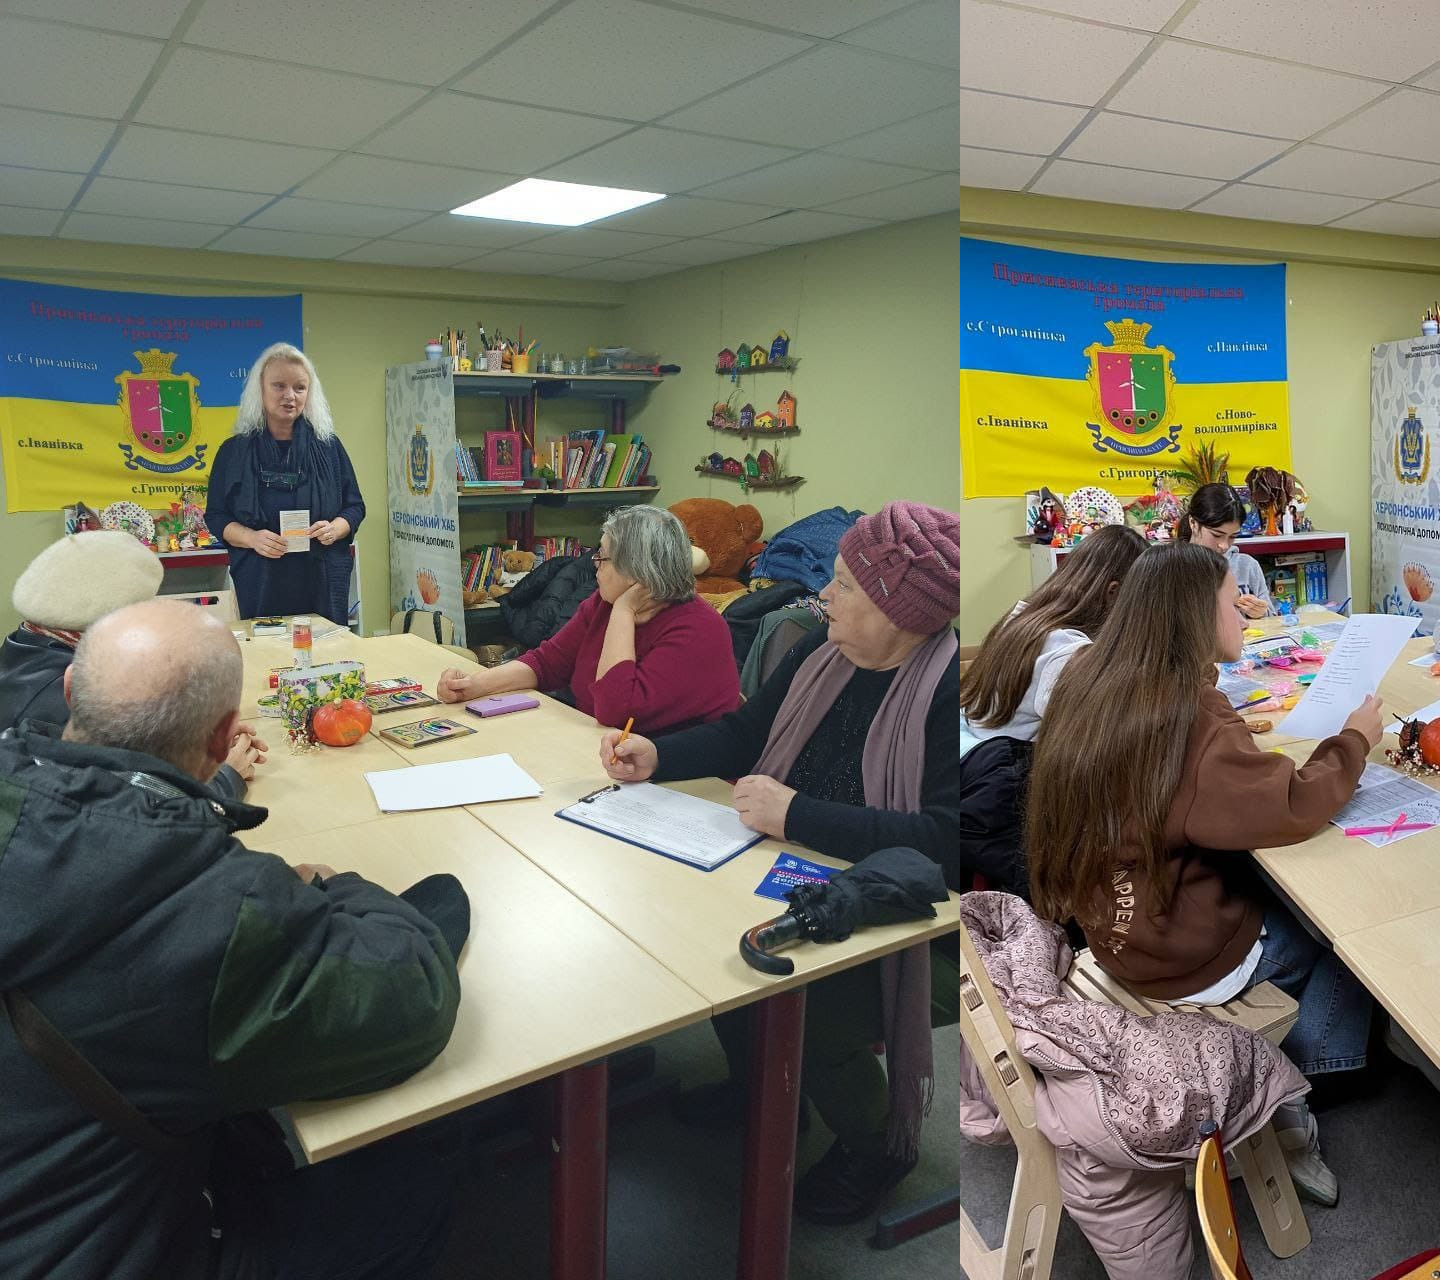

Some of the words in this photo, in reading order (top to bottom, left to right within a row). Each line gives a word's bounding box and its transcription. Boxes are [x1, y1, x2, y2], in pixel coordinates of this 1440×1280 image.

[1094, 295, 1165, 312] громада
[1207, 341, 1268, 353] с.Павлівка
[1216, 409, 1256, 420] с.Ново-
[977, 415, 1049, 429] с.Іванівка
[1194, 421, 1277, 435] володимирівка
[18, 437, 84, 451] с.Іванівка
[1375, 501, 1435, 521] ХЕРСОНСЬКИЙ
[392, 510, 440, 530] ХЕРСОНСЬКИЙ
[441, 517, 456, 532] ХАБ
